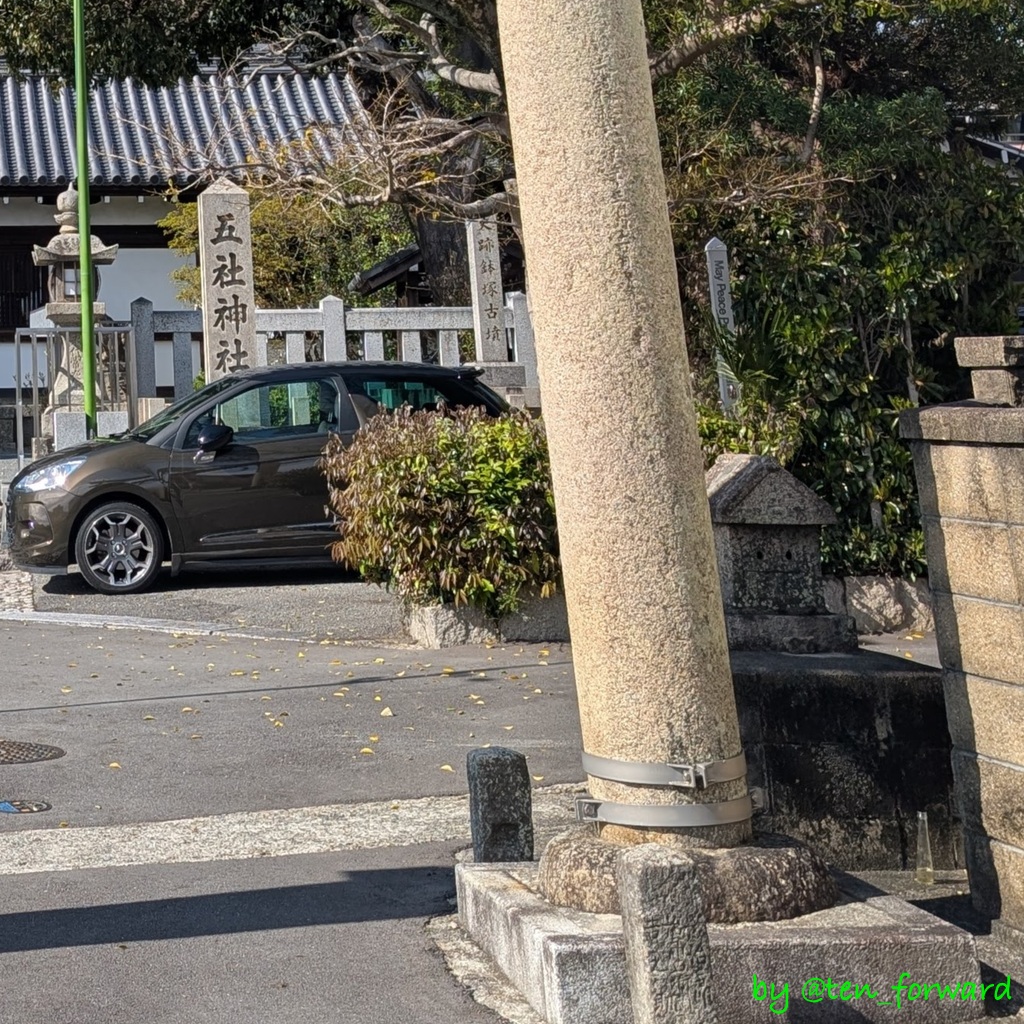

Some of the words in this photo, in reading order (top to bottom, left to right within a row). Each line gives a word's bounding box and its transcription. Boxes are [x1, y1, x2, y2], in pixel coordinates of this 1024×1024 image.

[714, 260, 724, 281] May
[210, 213, 251, 373] 五社神社
[716, 283, 727, 316] Peace
